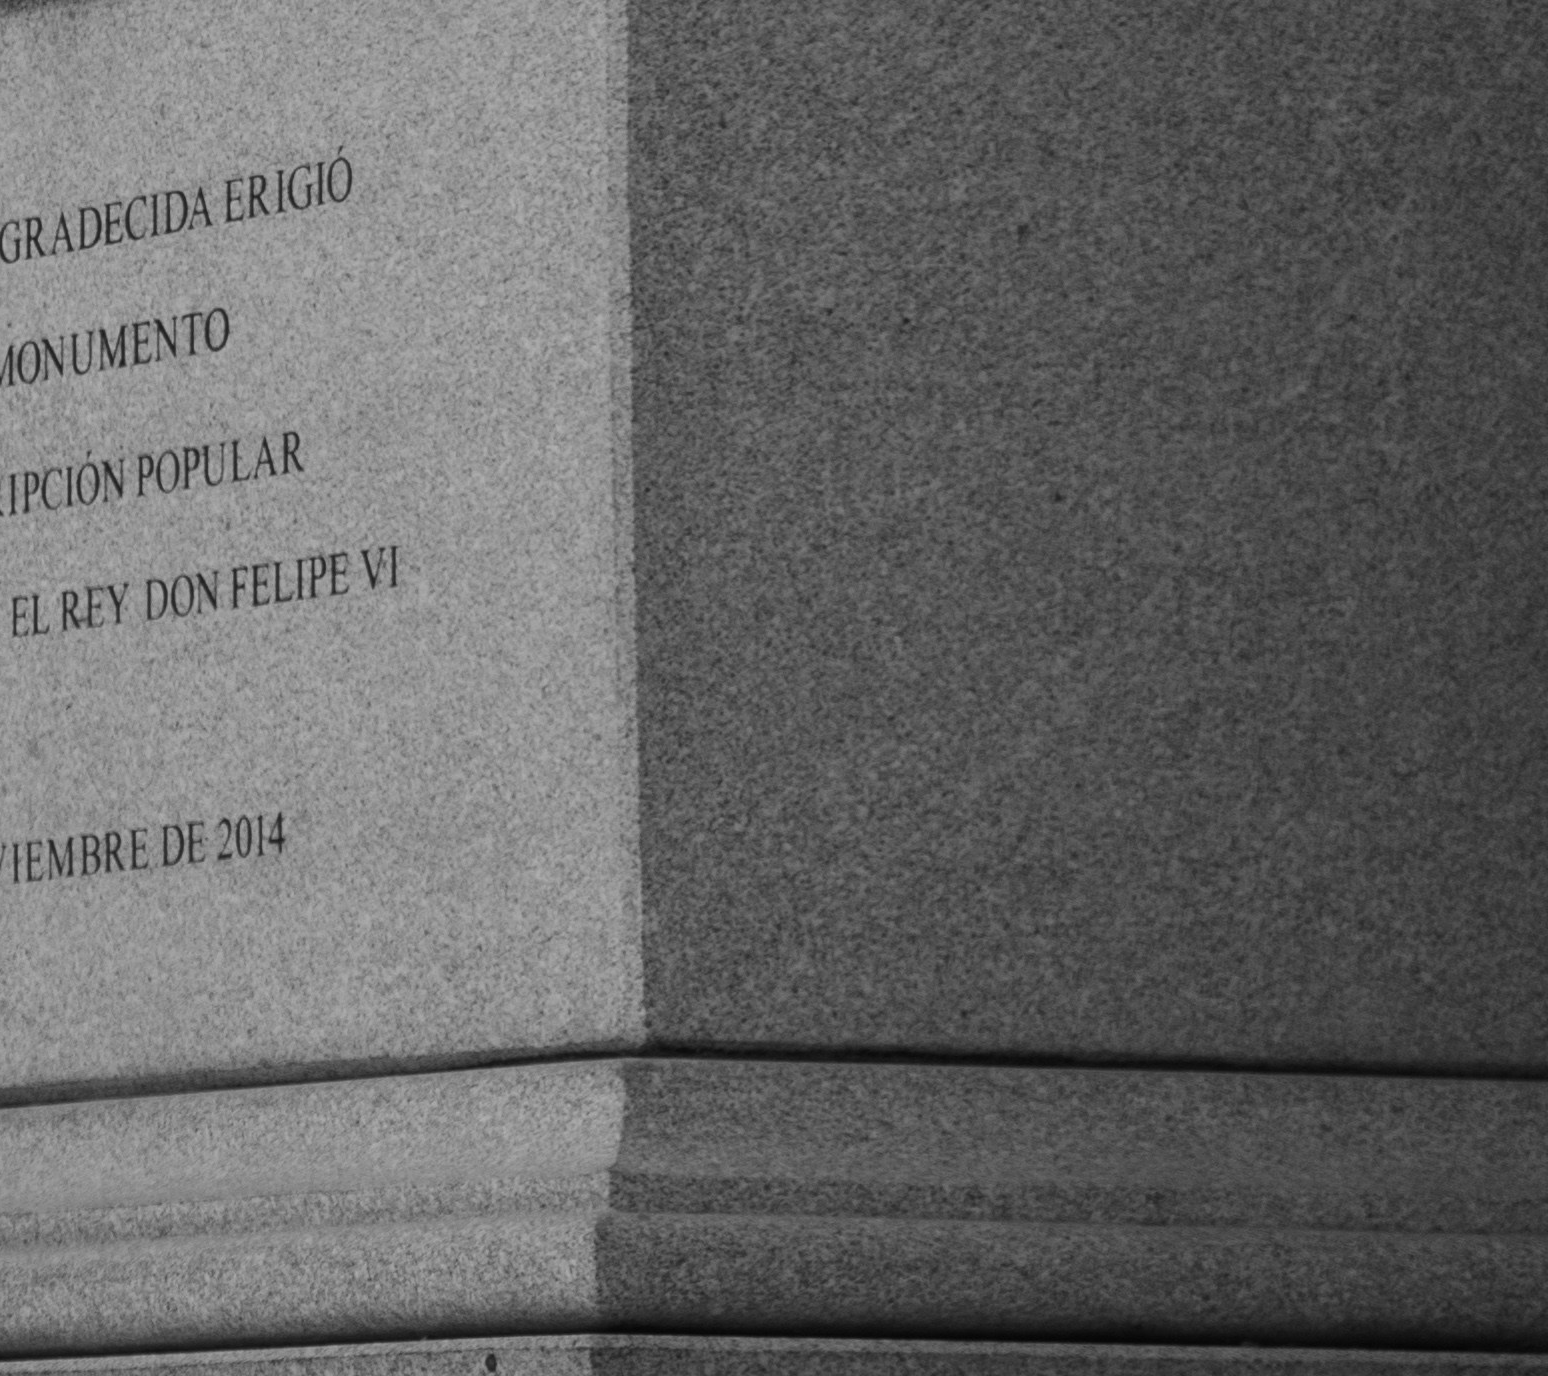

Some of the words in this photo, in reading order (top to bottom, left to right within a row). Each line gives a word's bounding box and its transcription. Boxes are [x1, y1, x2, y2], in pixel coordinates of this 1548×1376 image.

[224, 145, 354, 224] ERIGIÓ
[137, 430, 305, 498] POPULAR
[11, 593, 50, 638] EL
[61, 581, 130, 632] REY
[145, 570, 219, 621] DON
[231, 551, 350, 610] FELIPE
[360, 544, 399, 590] VI
[161, 821, 205, 868] DE
[216, 811, 287, 862] 2014
